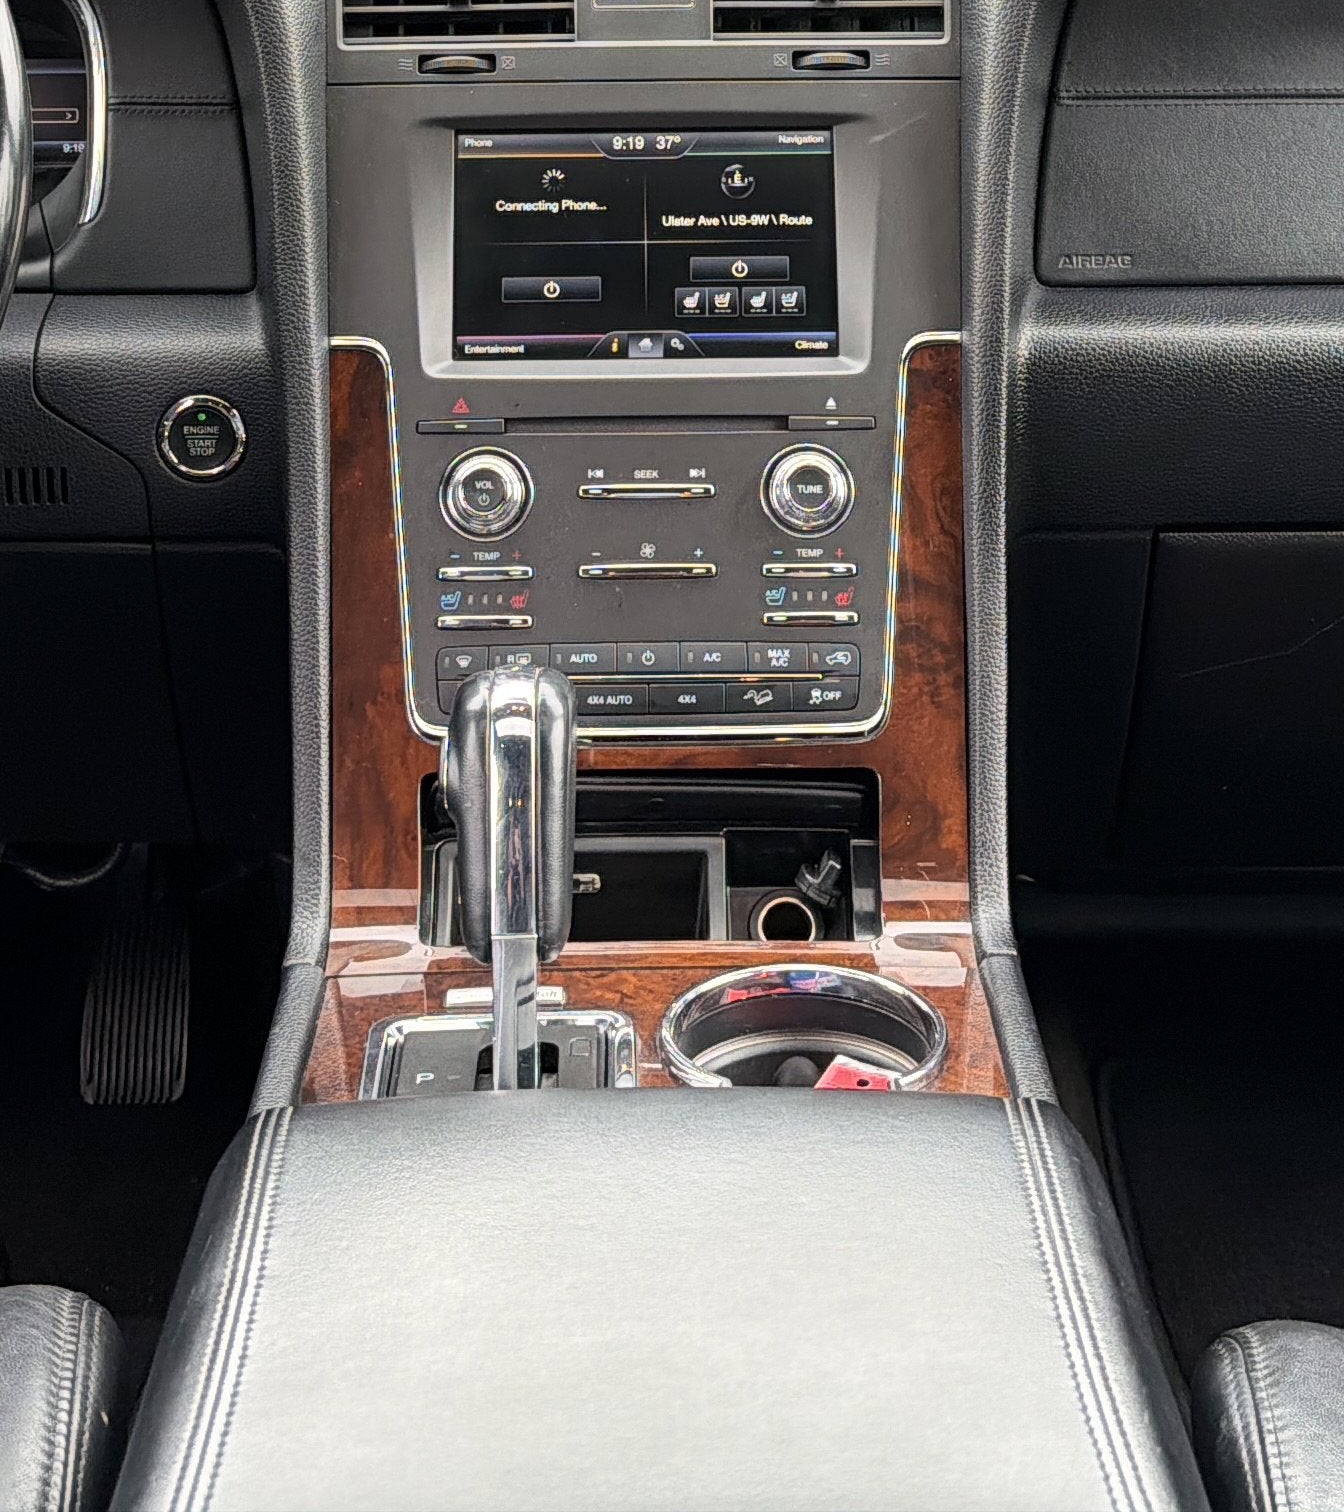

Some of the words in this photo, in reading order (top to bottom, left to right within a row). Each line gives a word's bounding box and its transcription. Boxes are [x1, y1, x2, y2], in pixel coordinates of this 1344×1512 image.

[464, 138, 493, 148] Phone
[612, 135, 645, 150] 9:19
[778, 134, 825, 146] Navigation
[495, 199, 559, 213] Connecting
[561, 199, 607, 211] Phone...
[662, 215, 696, 227] Ulster
[697, 215, 720, 227] Ave
[729, 214, 769, 226] US-9W
[779, 214, 813, 226] Route
[1058, 254, 1133, 269] AIRBAG
[464, 344, 525, 355] Entertainment
[794, 339, 829, 351] Climate
[183, 425, 220, 435] ENGINE
[186, 439, 217, 448] START
[189, 448, 216, 456] STOP
[634, 469, 659, 479] SEEK
[475, 480, 495, 490] VOL
[797, 484, 823, 494] TUNE
[473, 551, 501, 561] TEMP
[796, 548, 824, 558] TEMP
[570, 654, 598, 663] AUTO
[703, 652, 722, 662] A/C
[767, 649, 791, 658] MAX
[771, 657, 789, 667] A/C
[587, 695, 605, 705] 4X4
[606, 695, 633, 705] AUTO
[677, 694, 697, 704] 4X4
[822, 691, 842, 701] OFF
[416, 1072, 435, 1085] P
